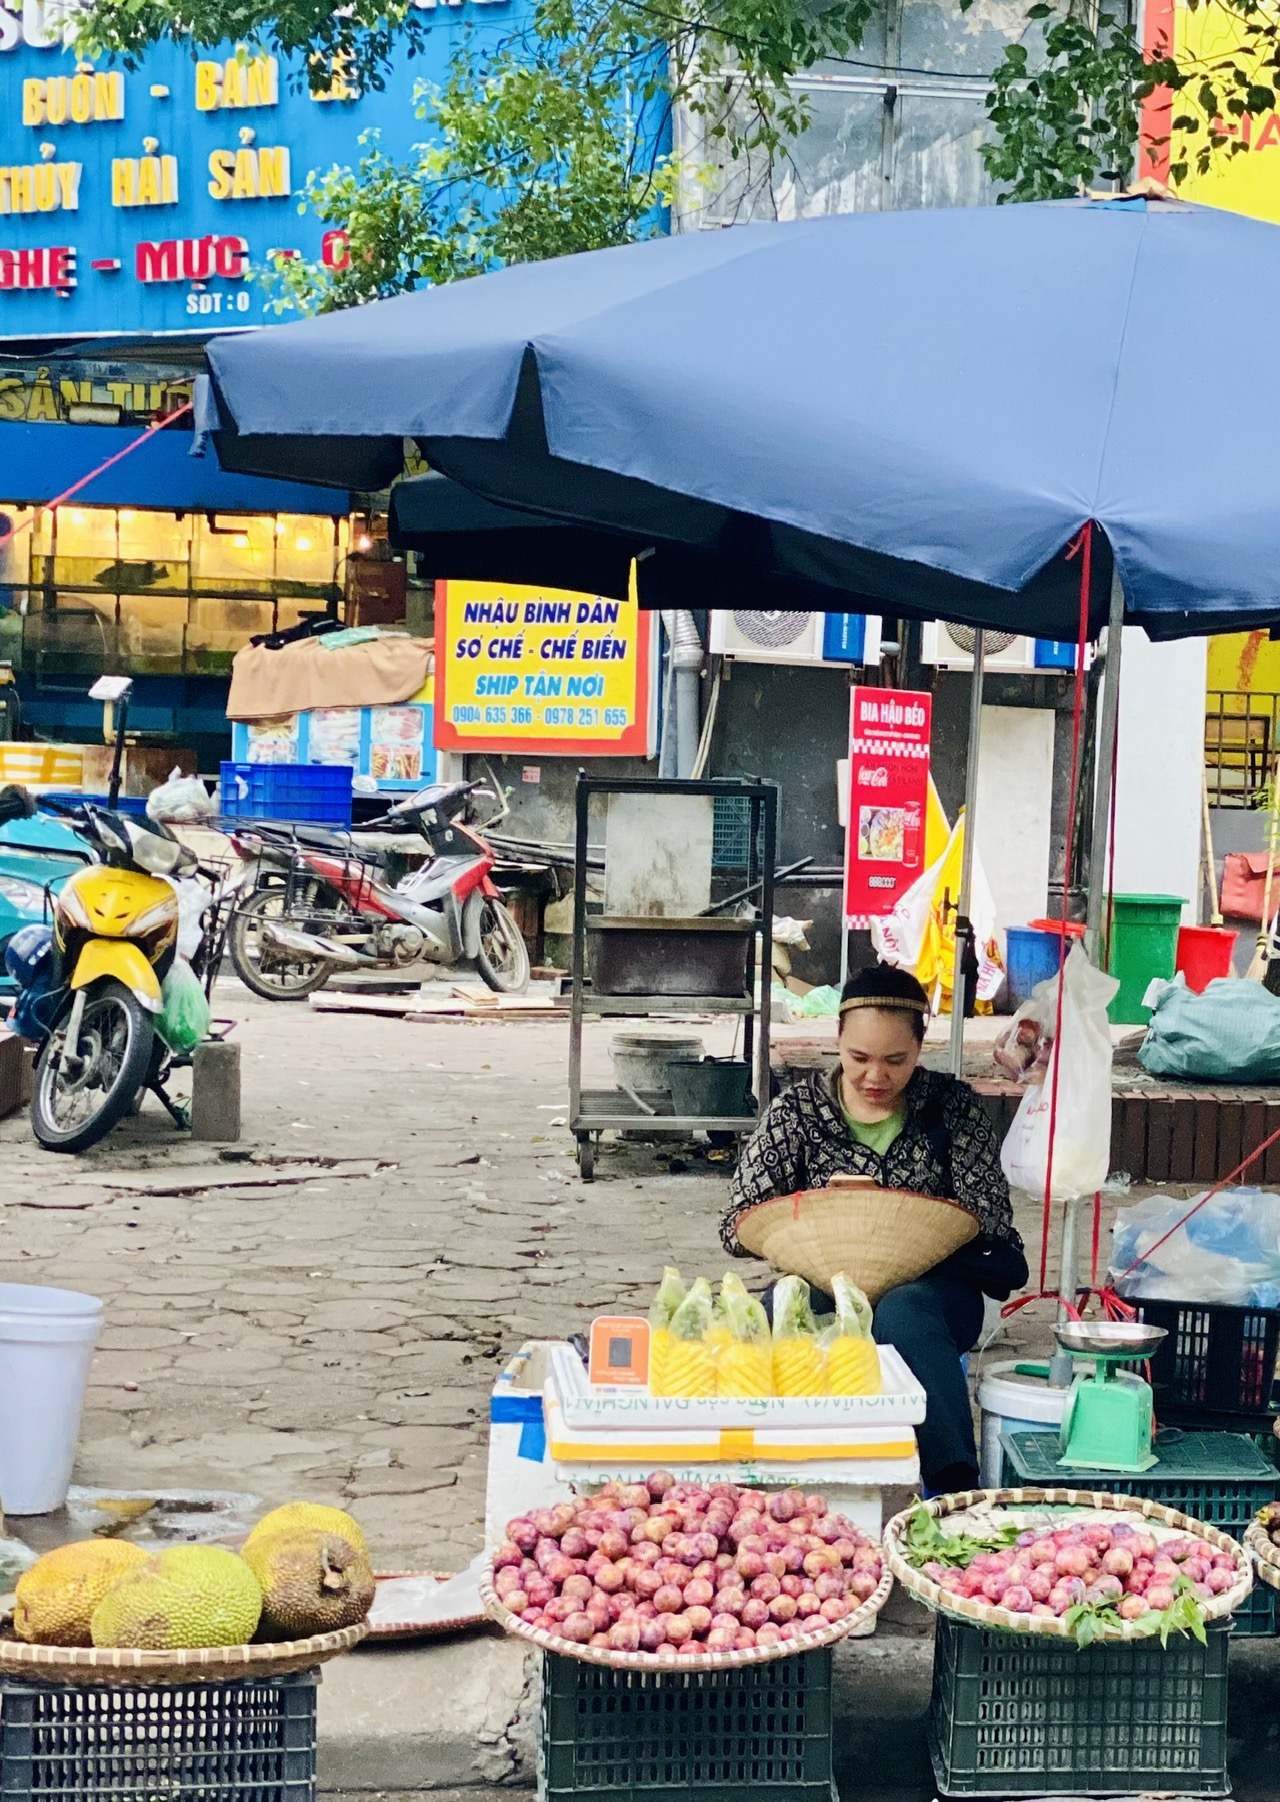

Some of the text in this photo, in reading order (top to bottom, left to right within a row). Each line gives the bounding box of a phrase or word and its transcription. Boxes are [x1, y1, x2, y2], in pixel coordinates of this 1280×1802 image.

[0, 126, 290, 214] THỦY HẢI SẢN
[136, 234, 249, 291] MỰC
[463, 595, 619, 630] NHẬU BÌNH DÂN
[455, 635, 485, 659] SƠ
[488, 629, 526, 659] CHẾ
[540, 629, 580, 660] CHẾ
[581, 629, 627, 660] BIẾN
[475, 671, 605, 703] SHIP TẬN NƠI
[453, 706, 481, 723] 0904
[485, 706, 507, 724] 635
[510, 707, 533, 724] 366
[544, 707, 575, 725] 0978
[578, 708, 600, 725] 251
[604, 708, 627, 726] 655
[860, 699, 926, 729] BIA HẬU BÉO
